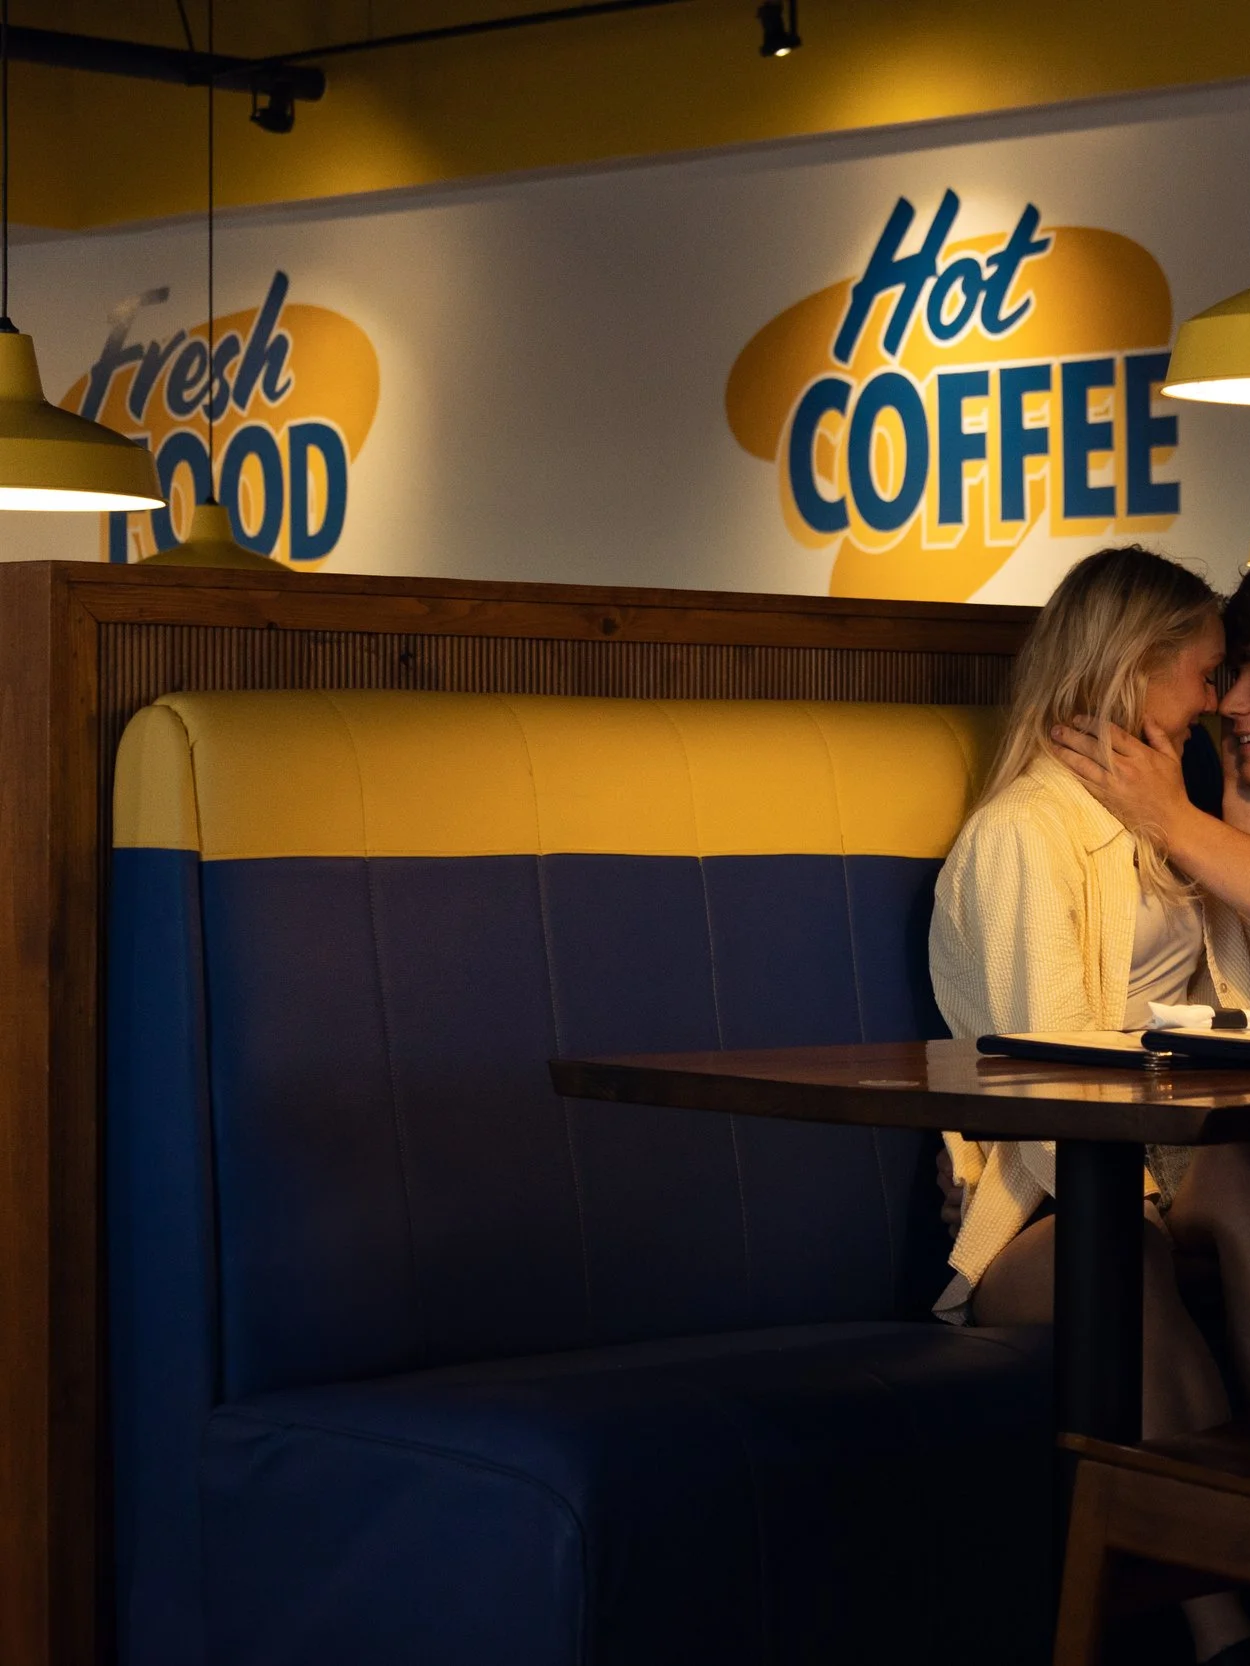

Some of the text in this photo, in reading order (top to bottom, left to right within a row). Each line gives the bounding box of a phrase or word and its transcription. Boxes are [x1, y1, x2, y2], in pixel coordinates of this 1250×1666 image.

[82, 270, 292, 421] Fresh
[833, 187, 1051, 364] Hot
[789, 352, 1181, 533] COFFEE
